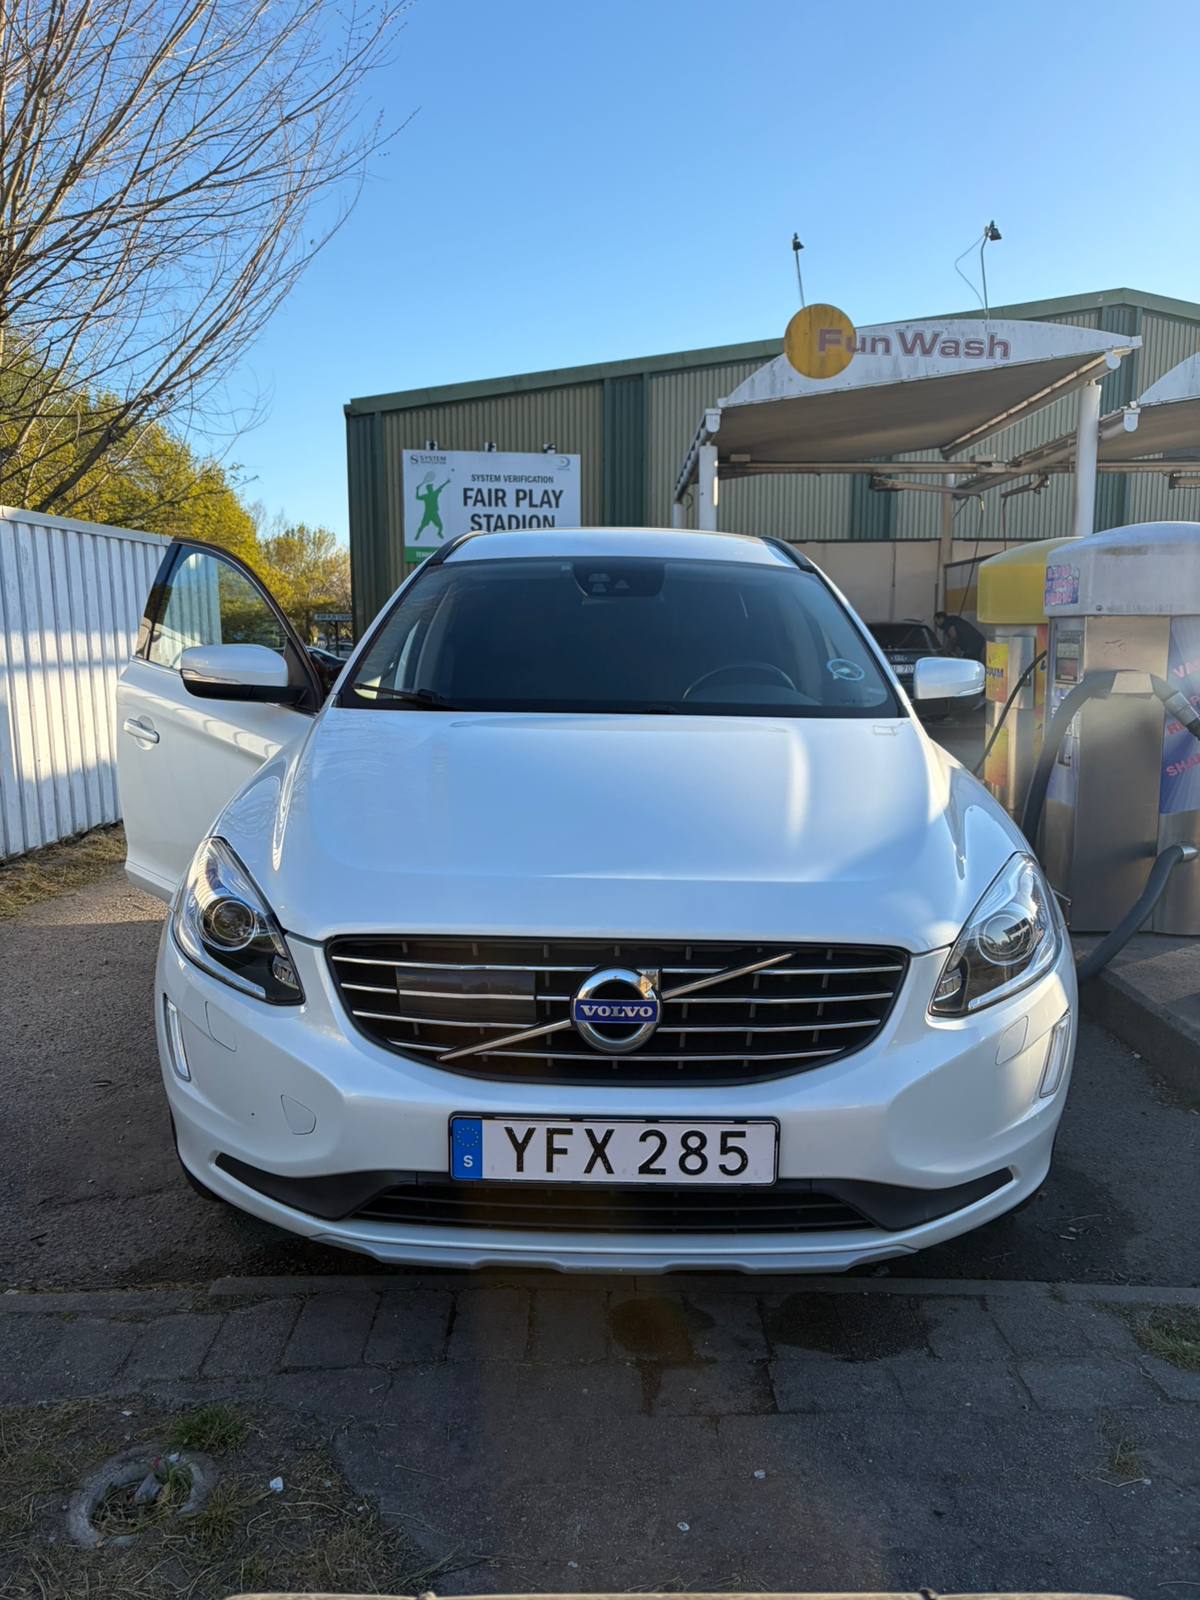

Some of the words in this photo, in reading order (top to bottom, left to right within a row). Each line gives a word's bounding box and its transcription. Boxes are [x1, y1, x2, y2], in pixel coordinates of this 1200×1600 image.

[471, 474, 501, 482] SYSTEM
[503, 475, 554, 484] VERIFICATION
[463, 487, 508, 508] FAIR
[515, 488, 564, 509] PLAY
[470, 513, 555, 533] STADION
[580, 1005, 653, 1017] VOLVO
[504, 1126, 615, 1174] YFX
[638, 1129, 748, 1176] 285
[463, 1154, 474, 1168] S
